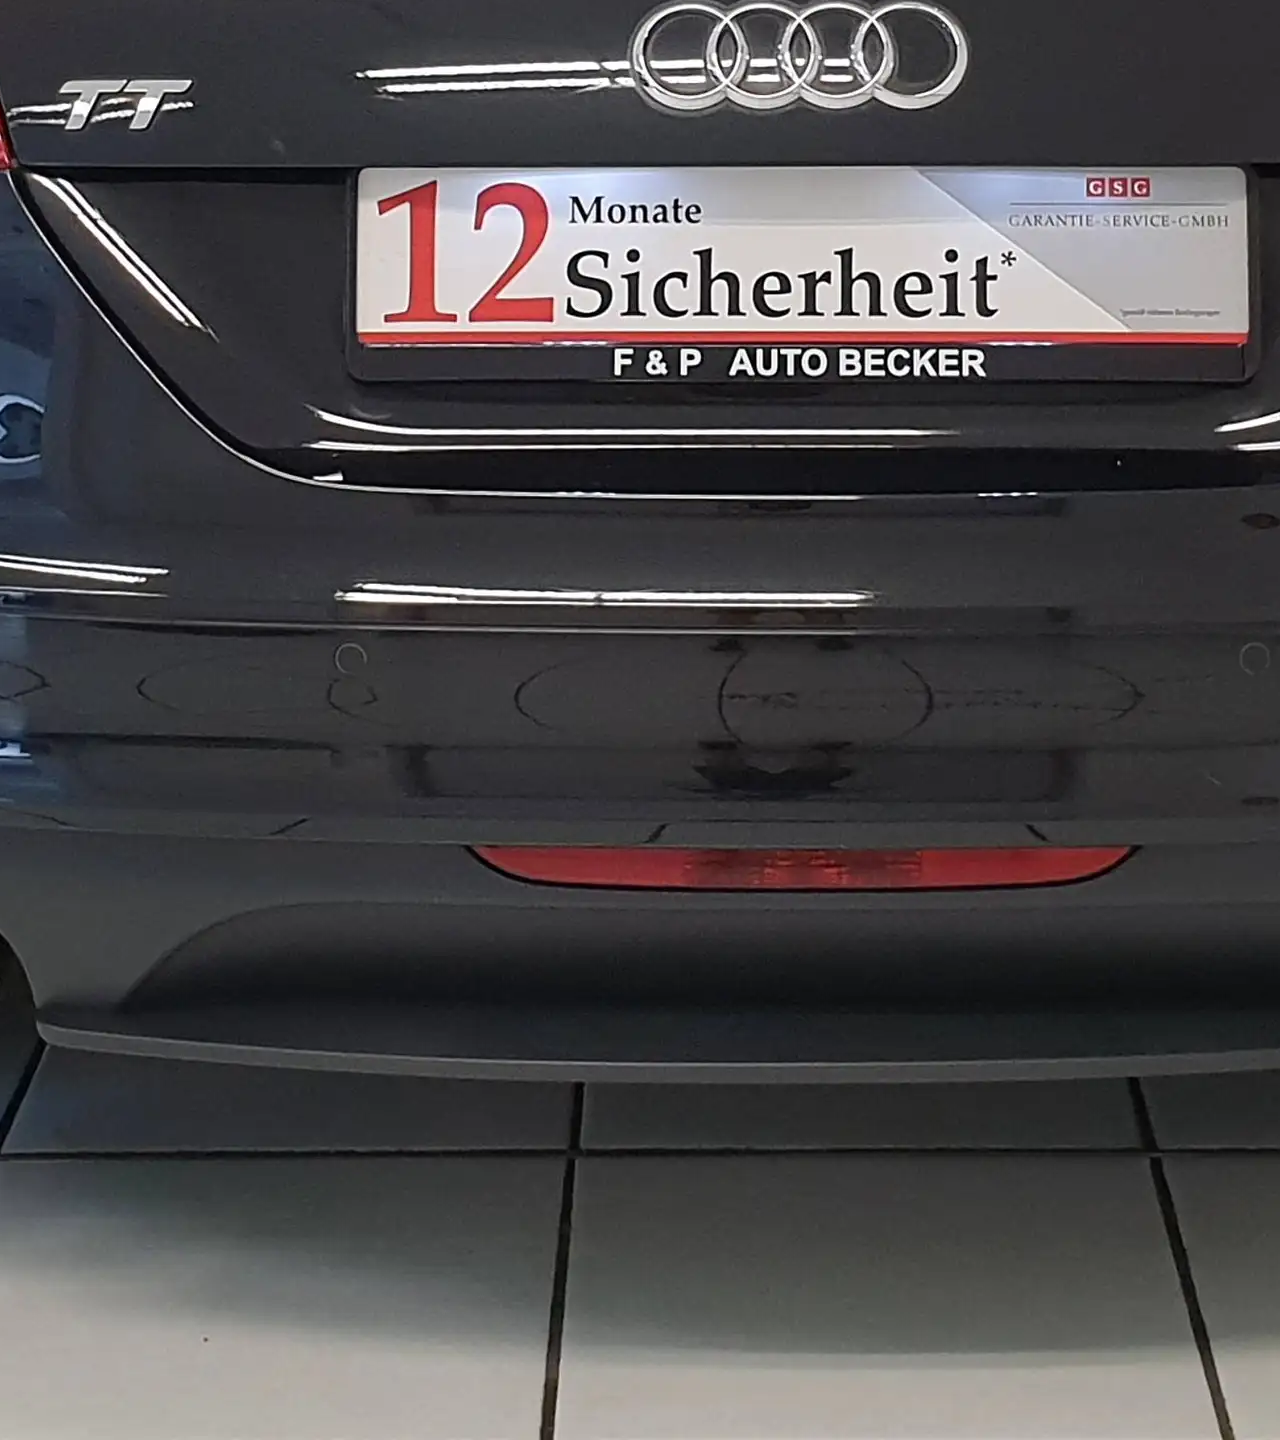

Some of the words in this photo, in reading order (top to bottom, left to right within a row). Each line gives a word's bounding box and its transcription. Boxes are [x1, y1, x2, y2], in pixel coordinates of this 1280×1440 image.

[59, 79, 193, 130] TT
[1087, 178, 1150, 196] GSG
[568, 195, 703, 224] Monate
[1008, 214, 1229, 228] GARANTIE-SERVICE-GMBH
[376, 179, 555, 323] 12
[613, 348, 634, 376] F
[645, 349, 668, 377] &
[680, 348, 702, 376] P
[729, 348, 827, 377] AUTO
[838, 348, 986, 377] BECKER
